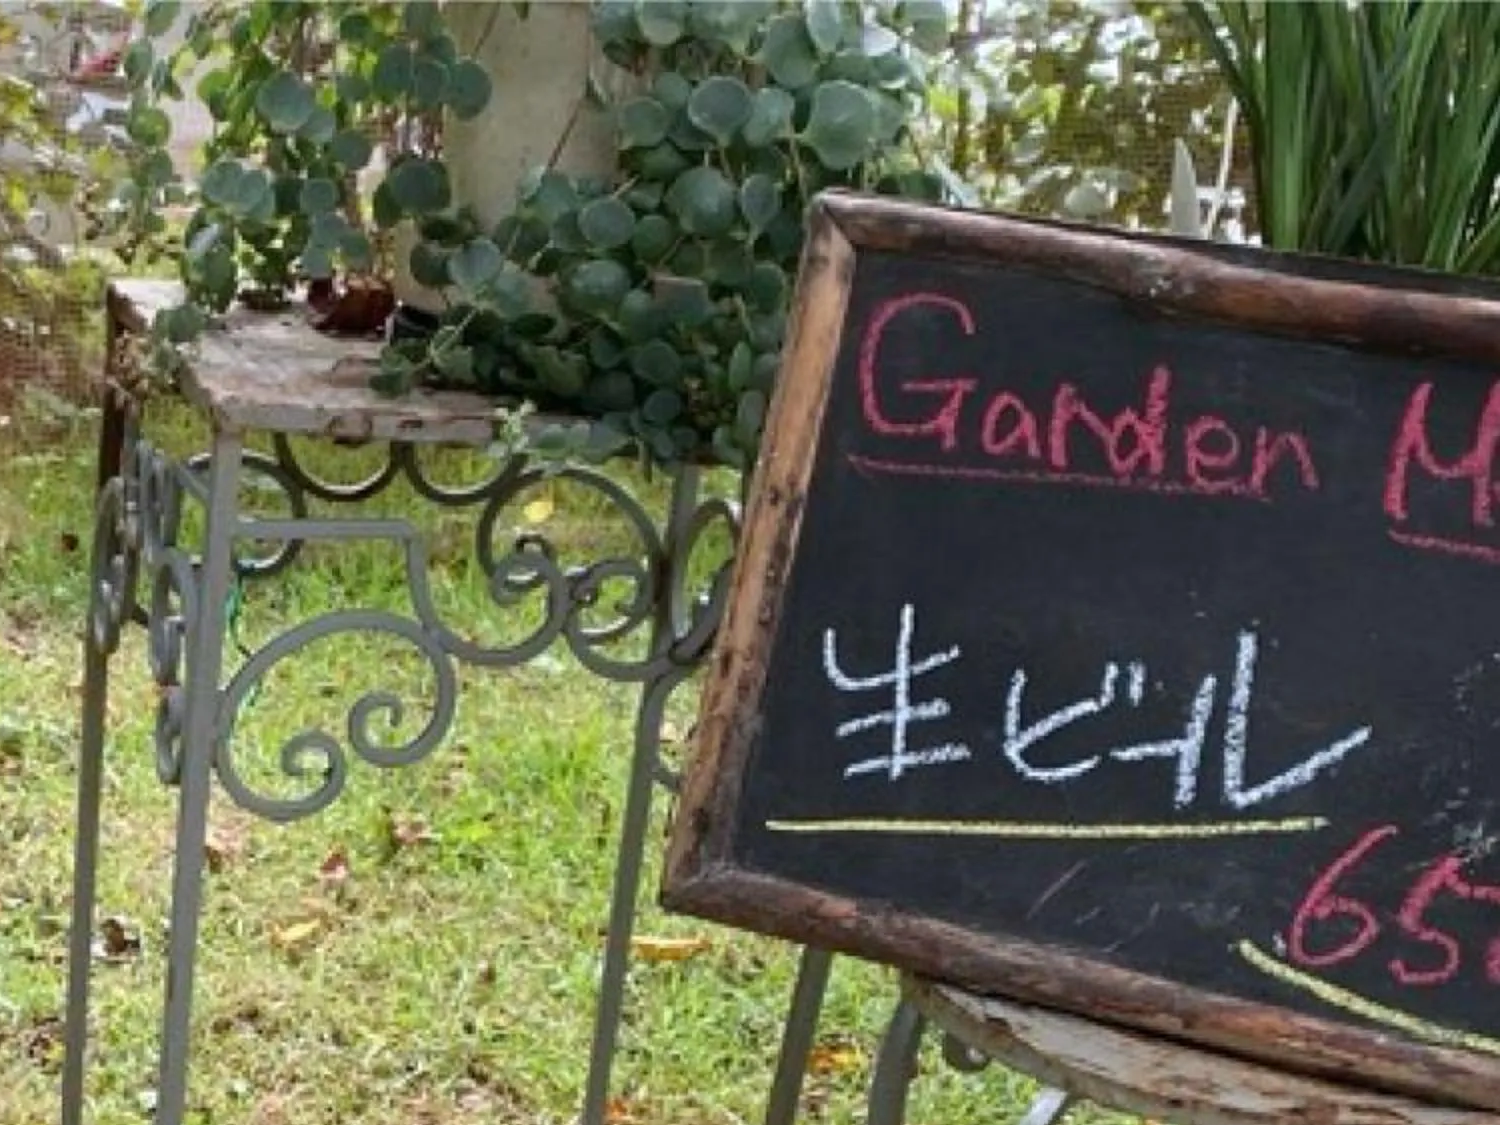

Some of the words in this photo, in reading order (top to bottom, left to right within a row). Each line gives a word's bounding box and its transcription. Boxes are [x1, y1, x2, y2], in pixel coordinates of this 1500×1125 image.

[857, 291, 1320, 491] Garden
[1383, 380, 1500, 528] M
[821, 604, 1372, 808] 生ビール
[1288, 824, 1500, 986] 65
